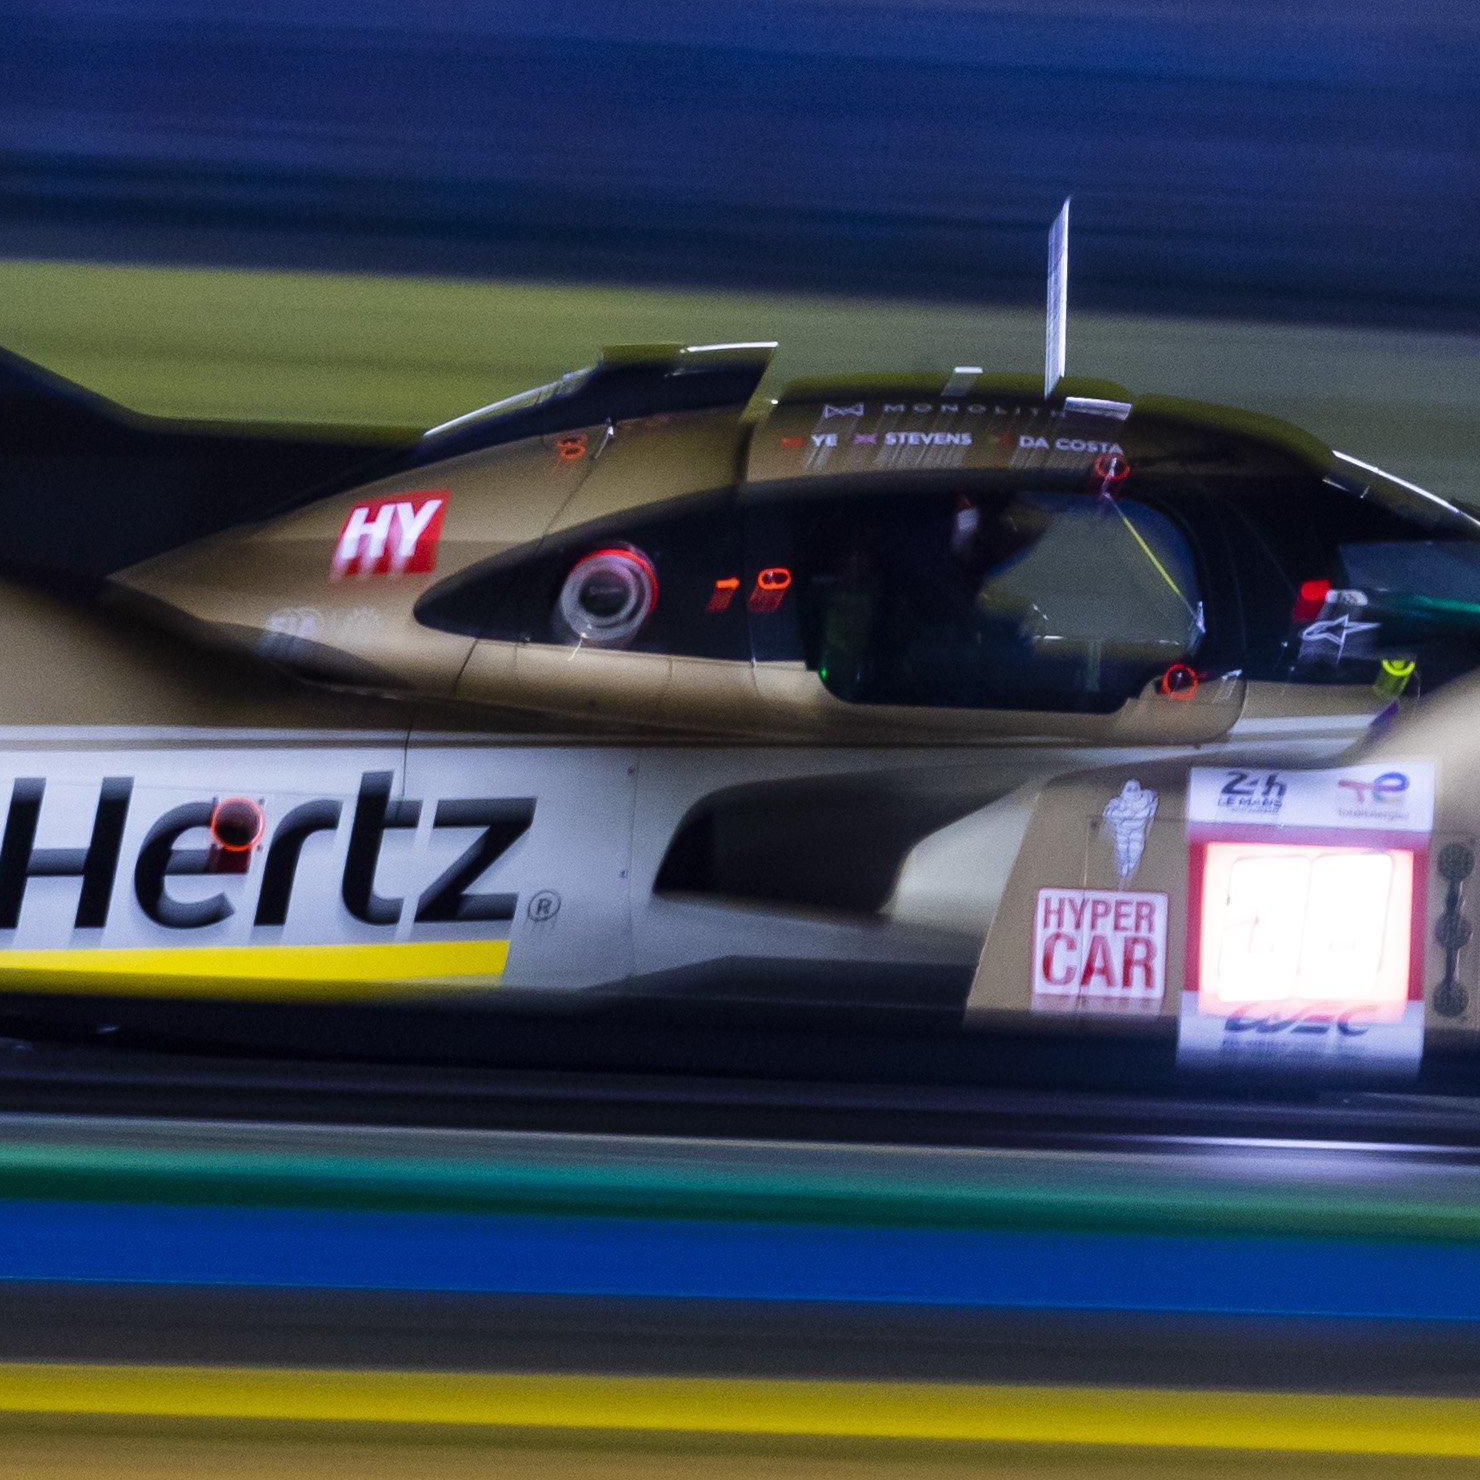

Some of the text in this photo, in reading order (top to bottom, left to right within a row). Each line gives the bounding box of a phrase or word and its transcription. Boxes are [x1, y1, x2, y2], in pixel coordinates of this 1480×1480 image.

[811, 433, 838, 448] YE
[884, 432, 972, 446] STEVENS
[1020, 435, 1123, 455] DA COSTA
[342, 499, 442, 560] HY
[1044, 898, 1156, 933] HYPER
[1043, 932, 1156, 989] CAR
